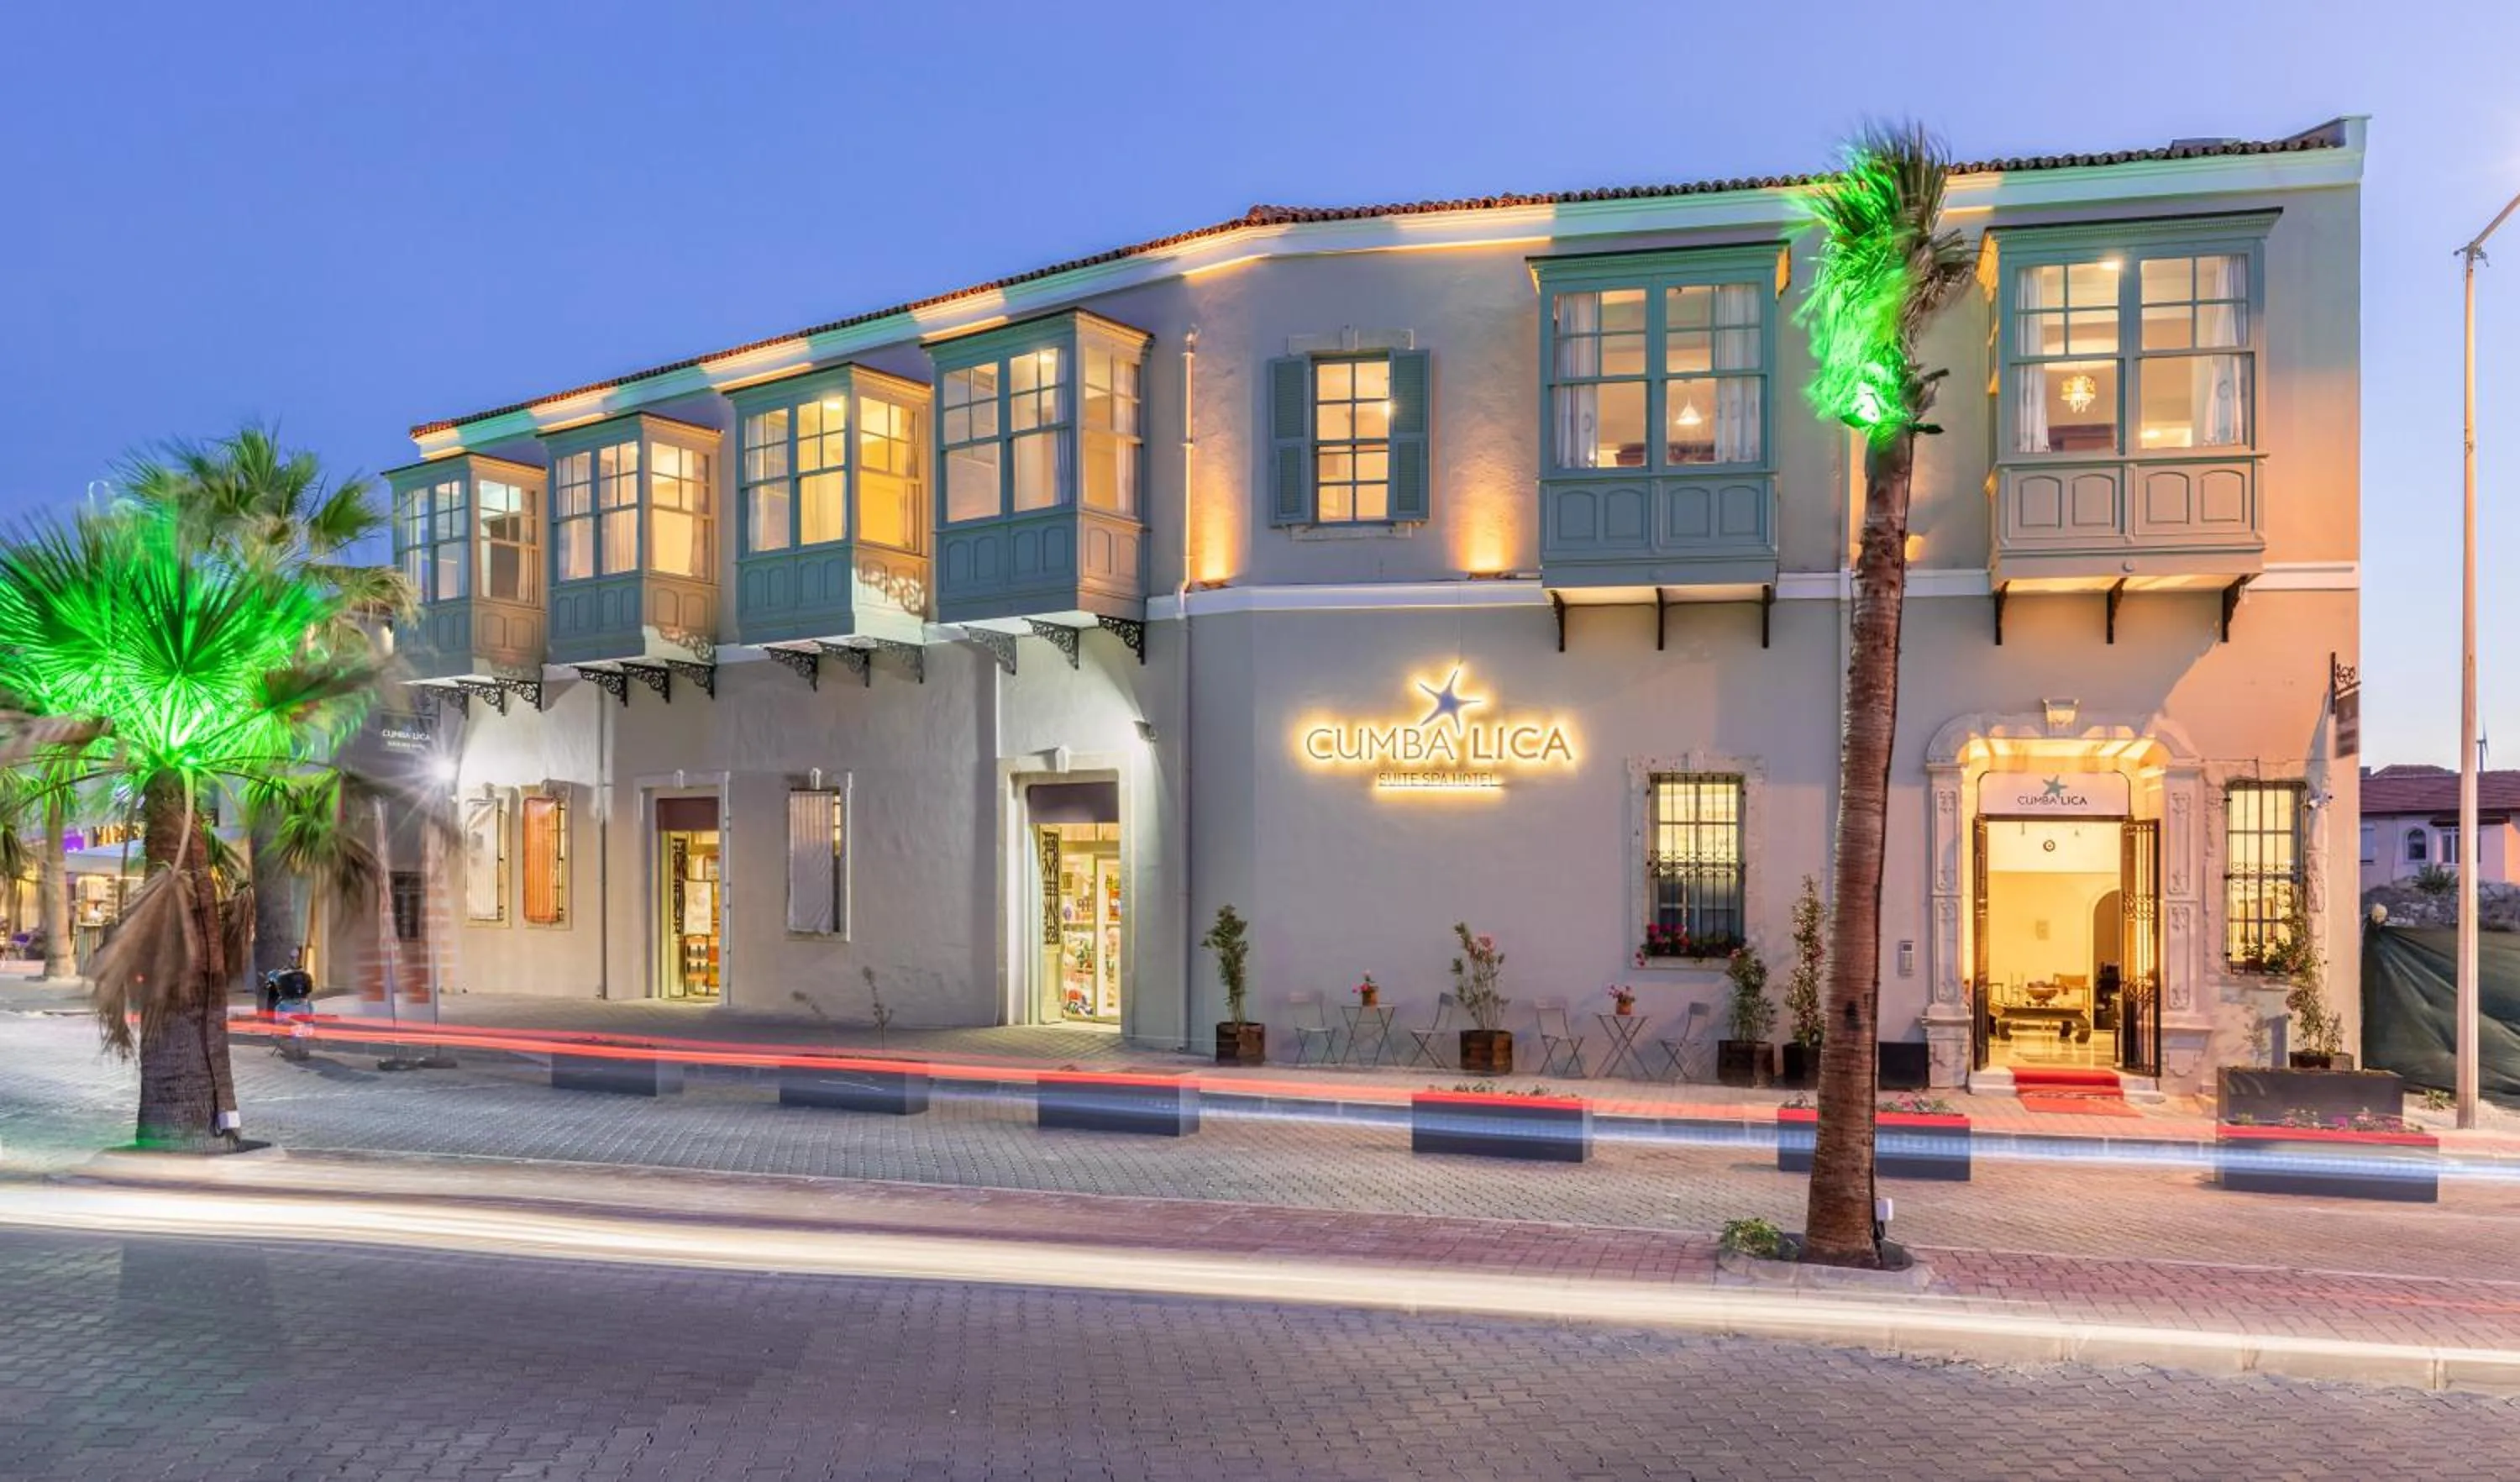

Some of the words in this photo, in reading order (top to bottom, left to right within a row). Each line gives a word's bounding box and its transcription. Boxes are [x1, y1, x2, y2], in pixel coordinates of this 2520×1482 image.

[1306, 727, 1456, 760] CUMBA
[1473, 727, 1573, 760] LICA
[1378, 772, 1419, 785] SUITE
[1421, 772, 1448, 785] SPA
[1452, 772, 1494, 785] HOTEL
[2017, 796, 2058, 806] CUMBA
[2061, 796, 2087, 806] LICA
